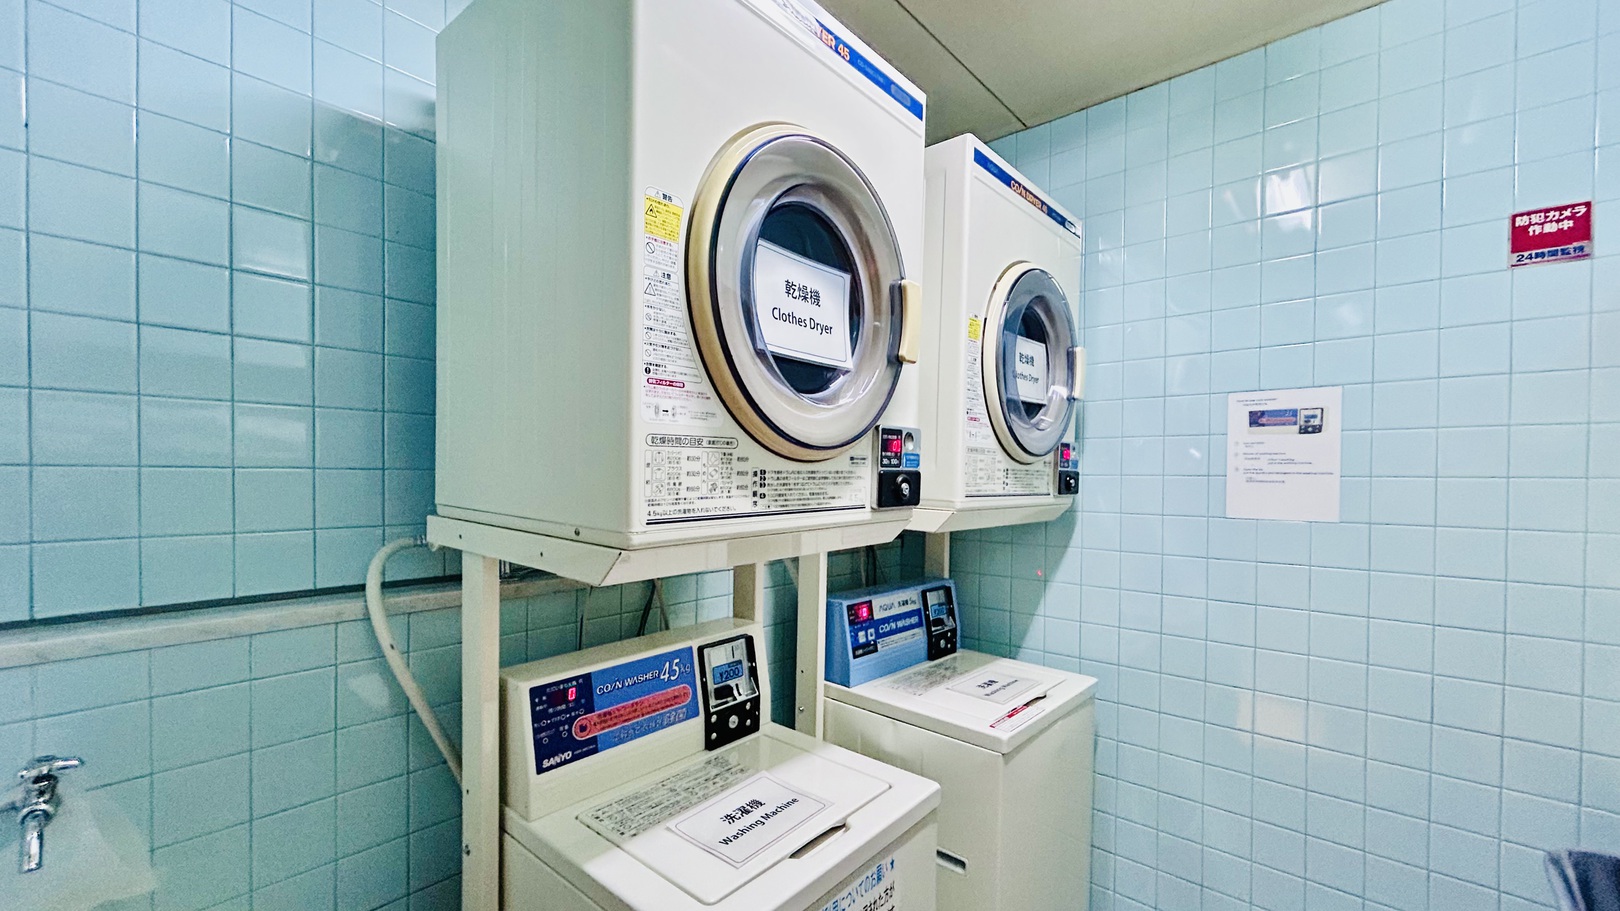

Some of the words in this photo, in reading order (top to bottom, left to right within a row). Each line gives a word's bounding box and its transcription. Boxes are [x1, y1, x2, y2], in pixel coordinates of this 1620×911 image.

[837, 44, 850, 61] 45
[1515, 205, 1587, 227] 防犯カメラ
[1528, 219, 1574, 236] 作動中
[1516, 245, 1585, 263] 24時間監視
[784, 279, 821, 308] 乾燥機
[771, 307, 808, 328] Clothes
[809, 317, 833, 335] Dryer
[596, 679, 623, 695] COIN
[624, 669, 659, 687] WASHER
[719, 666, 740, 682] ¥200
[568, 687, 577, 701] 0
[542, 751, 573, 768] SANYO
[718, 819, 766, 846] Washing
[760, 797, 800, 821] Machine
[720, 799, 766, 825] 洗濯機
